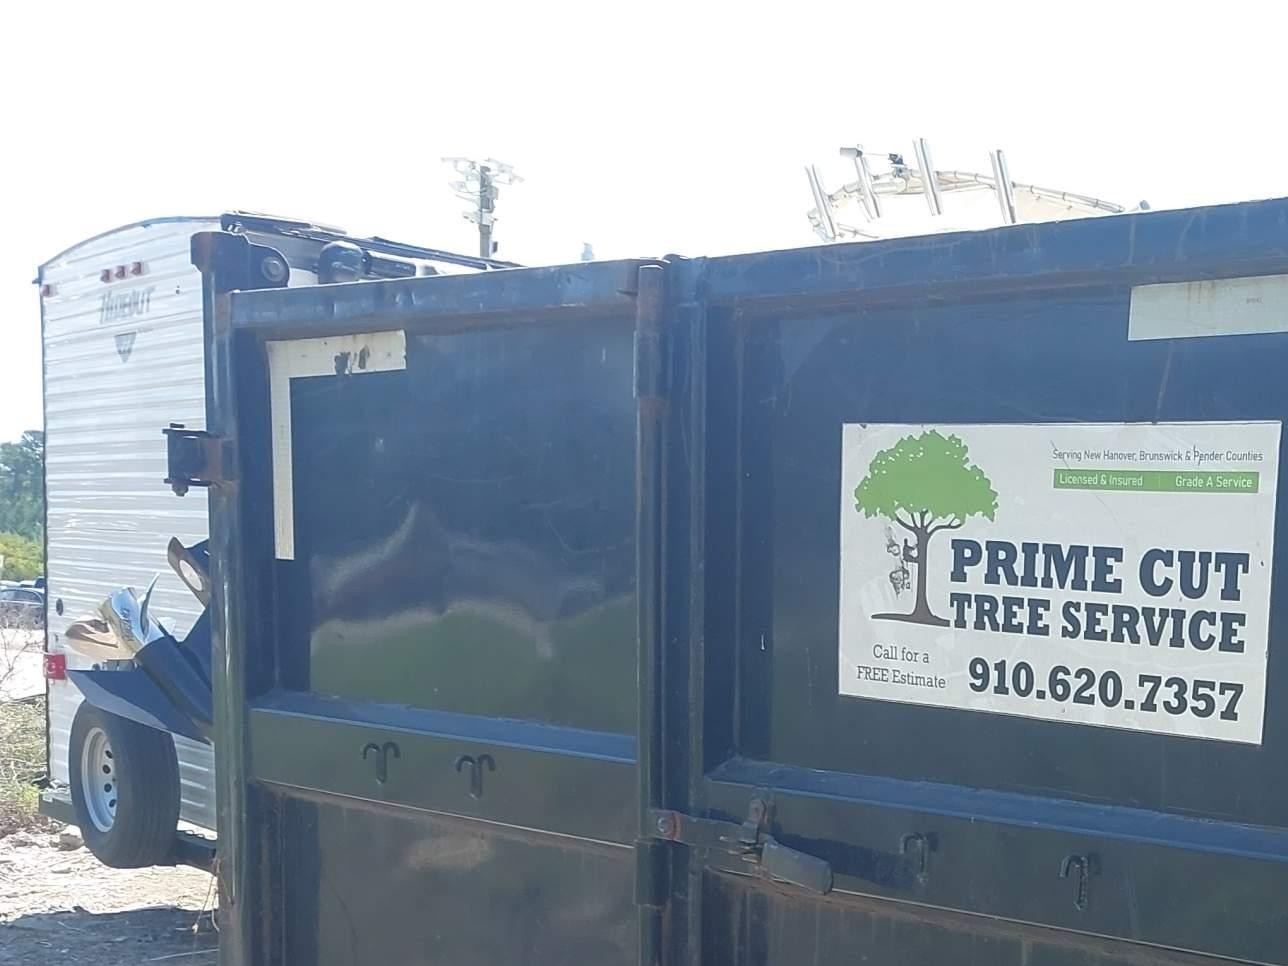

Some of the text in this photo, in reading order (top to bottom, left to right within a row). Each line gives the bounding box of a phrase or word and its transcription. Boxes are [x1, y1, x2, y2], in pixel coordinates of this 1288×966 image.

[1052, 450, 1263, 462] Serving New Hanover, Brunswick & Pender Counties
[1059, 473, 1143, 487] Licensed & Insured
[1175, 476, 1253, 488] Grade A Service
[949, 538, 1250, 602] PRIME CUT
[949, 592, 1247, 654] TREE SERVICE
[872, 644, 930, 664] Call for a
[856, 665, 946, 689] FREE Estimate
[967, 657, 1245, 722] 910.620.7357
